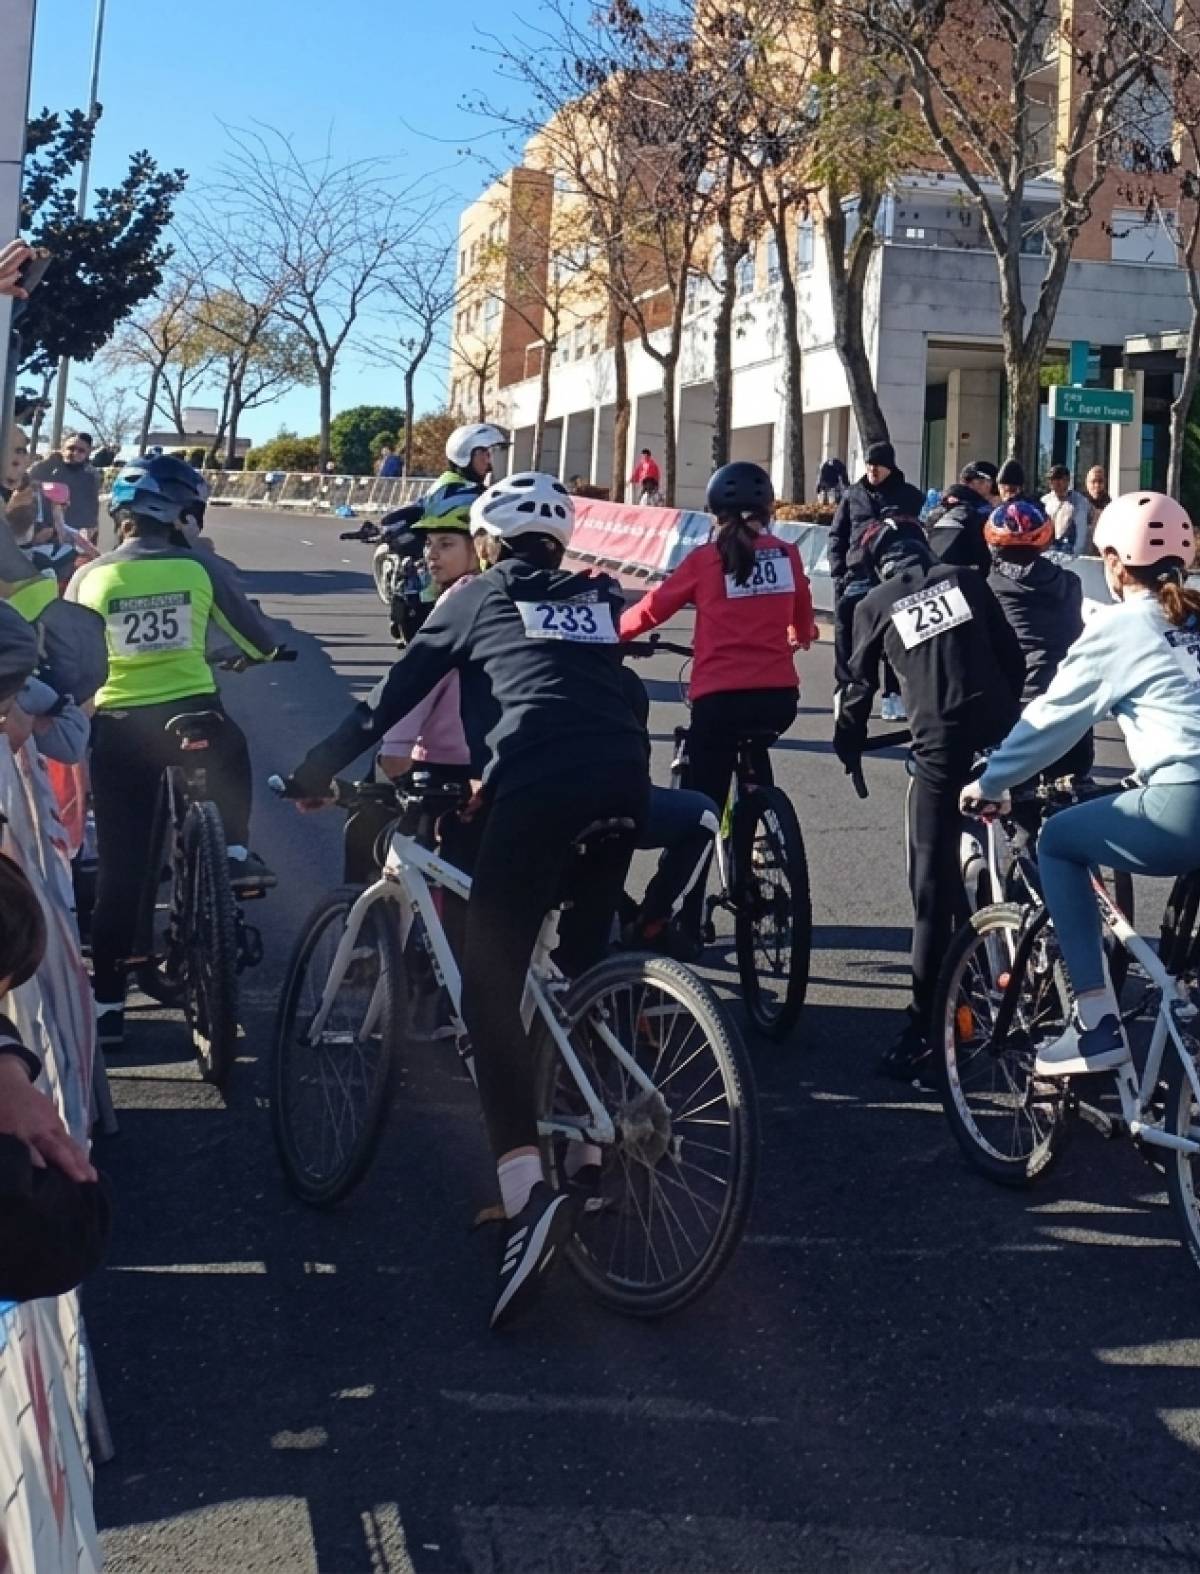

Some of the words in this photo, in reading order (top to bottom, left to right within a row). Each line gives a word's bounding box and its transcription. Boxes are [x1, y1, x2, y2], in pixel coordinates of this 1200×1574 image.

[123, 608, 179, 645] 235
[535, 605, 597, 634] 233
[906, 595, 952, 632] 231
